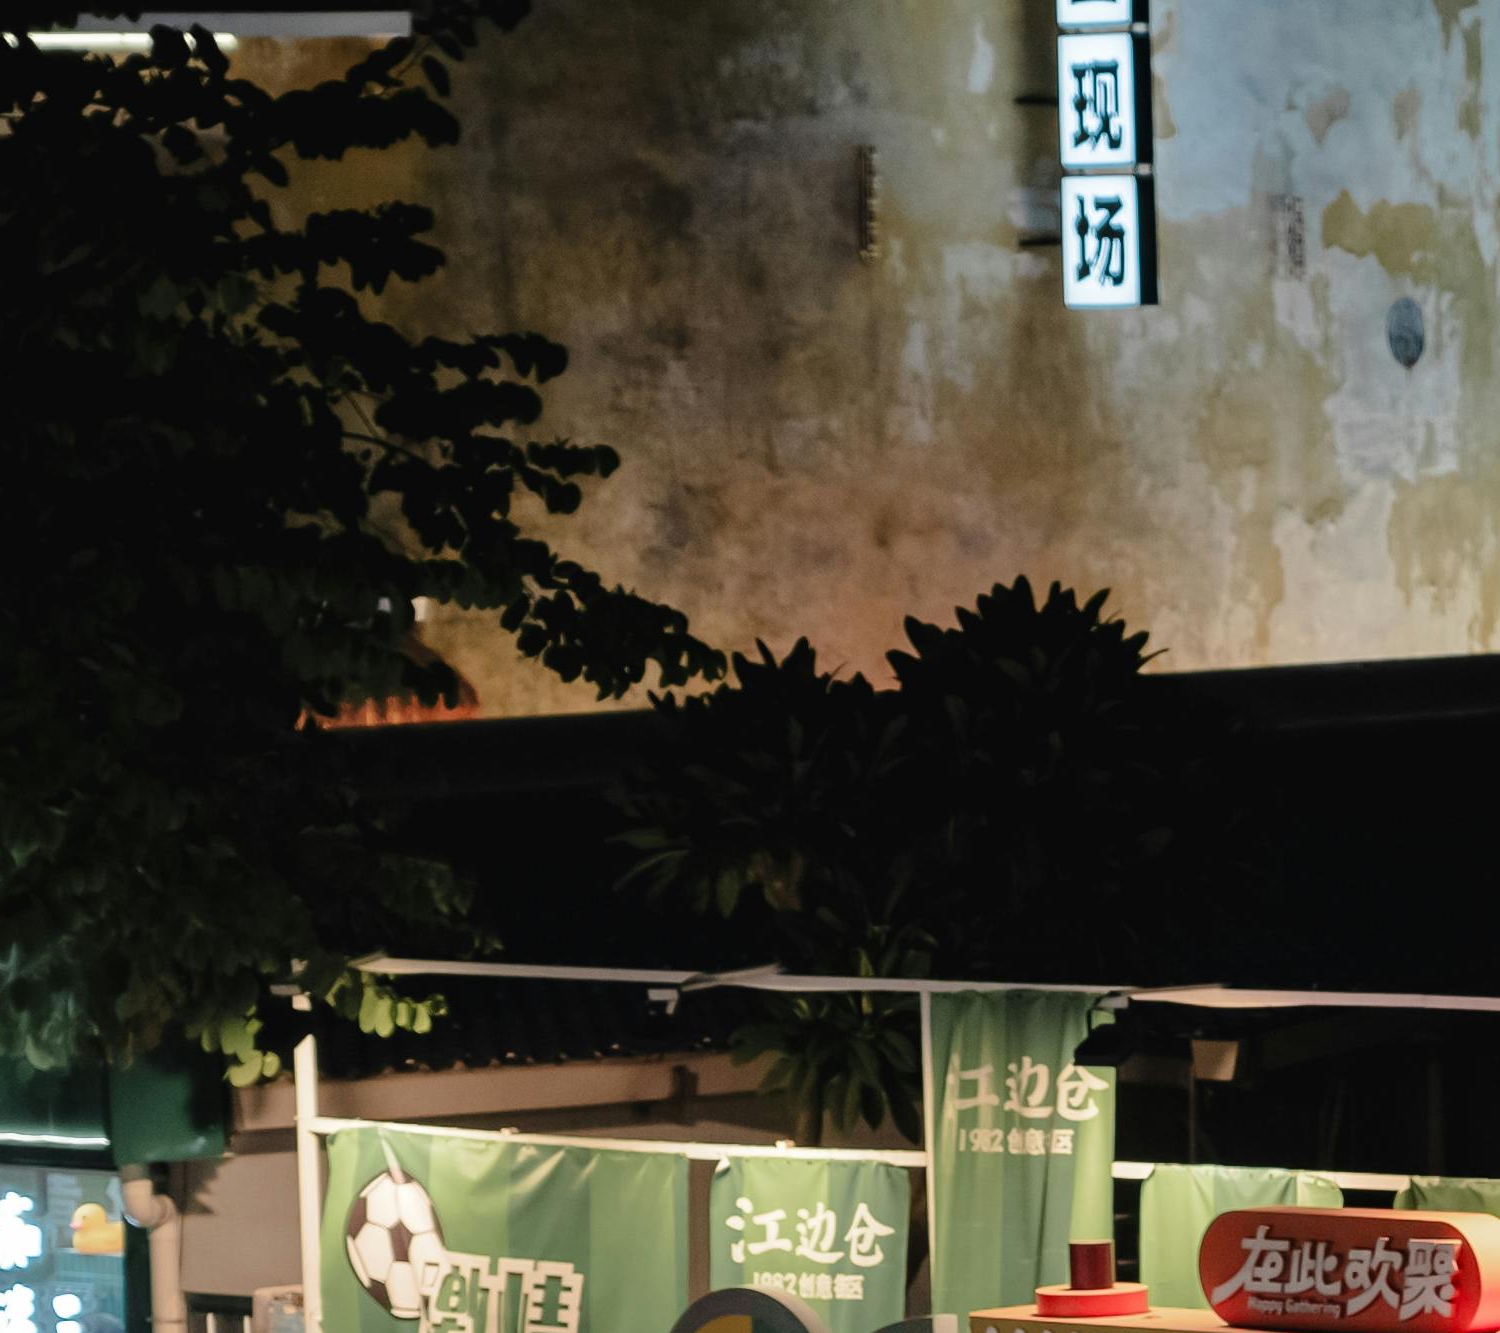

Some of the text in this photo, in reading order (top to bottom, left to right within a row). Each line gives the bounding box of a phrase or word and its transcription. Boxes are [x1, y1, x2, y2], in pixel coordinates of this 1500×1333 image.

[725, 1197, 895, 1268] 江边仓
[1211, 1225, 1462, 1322] 在此欢聚
